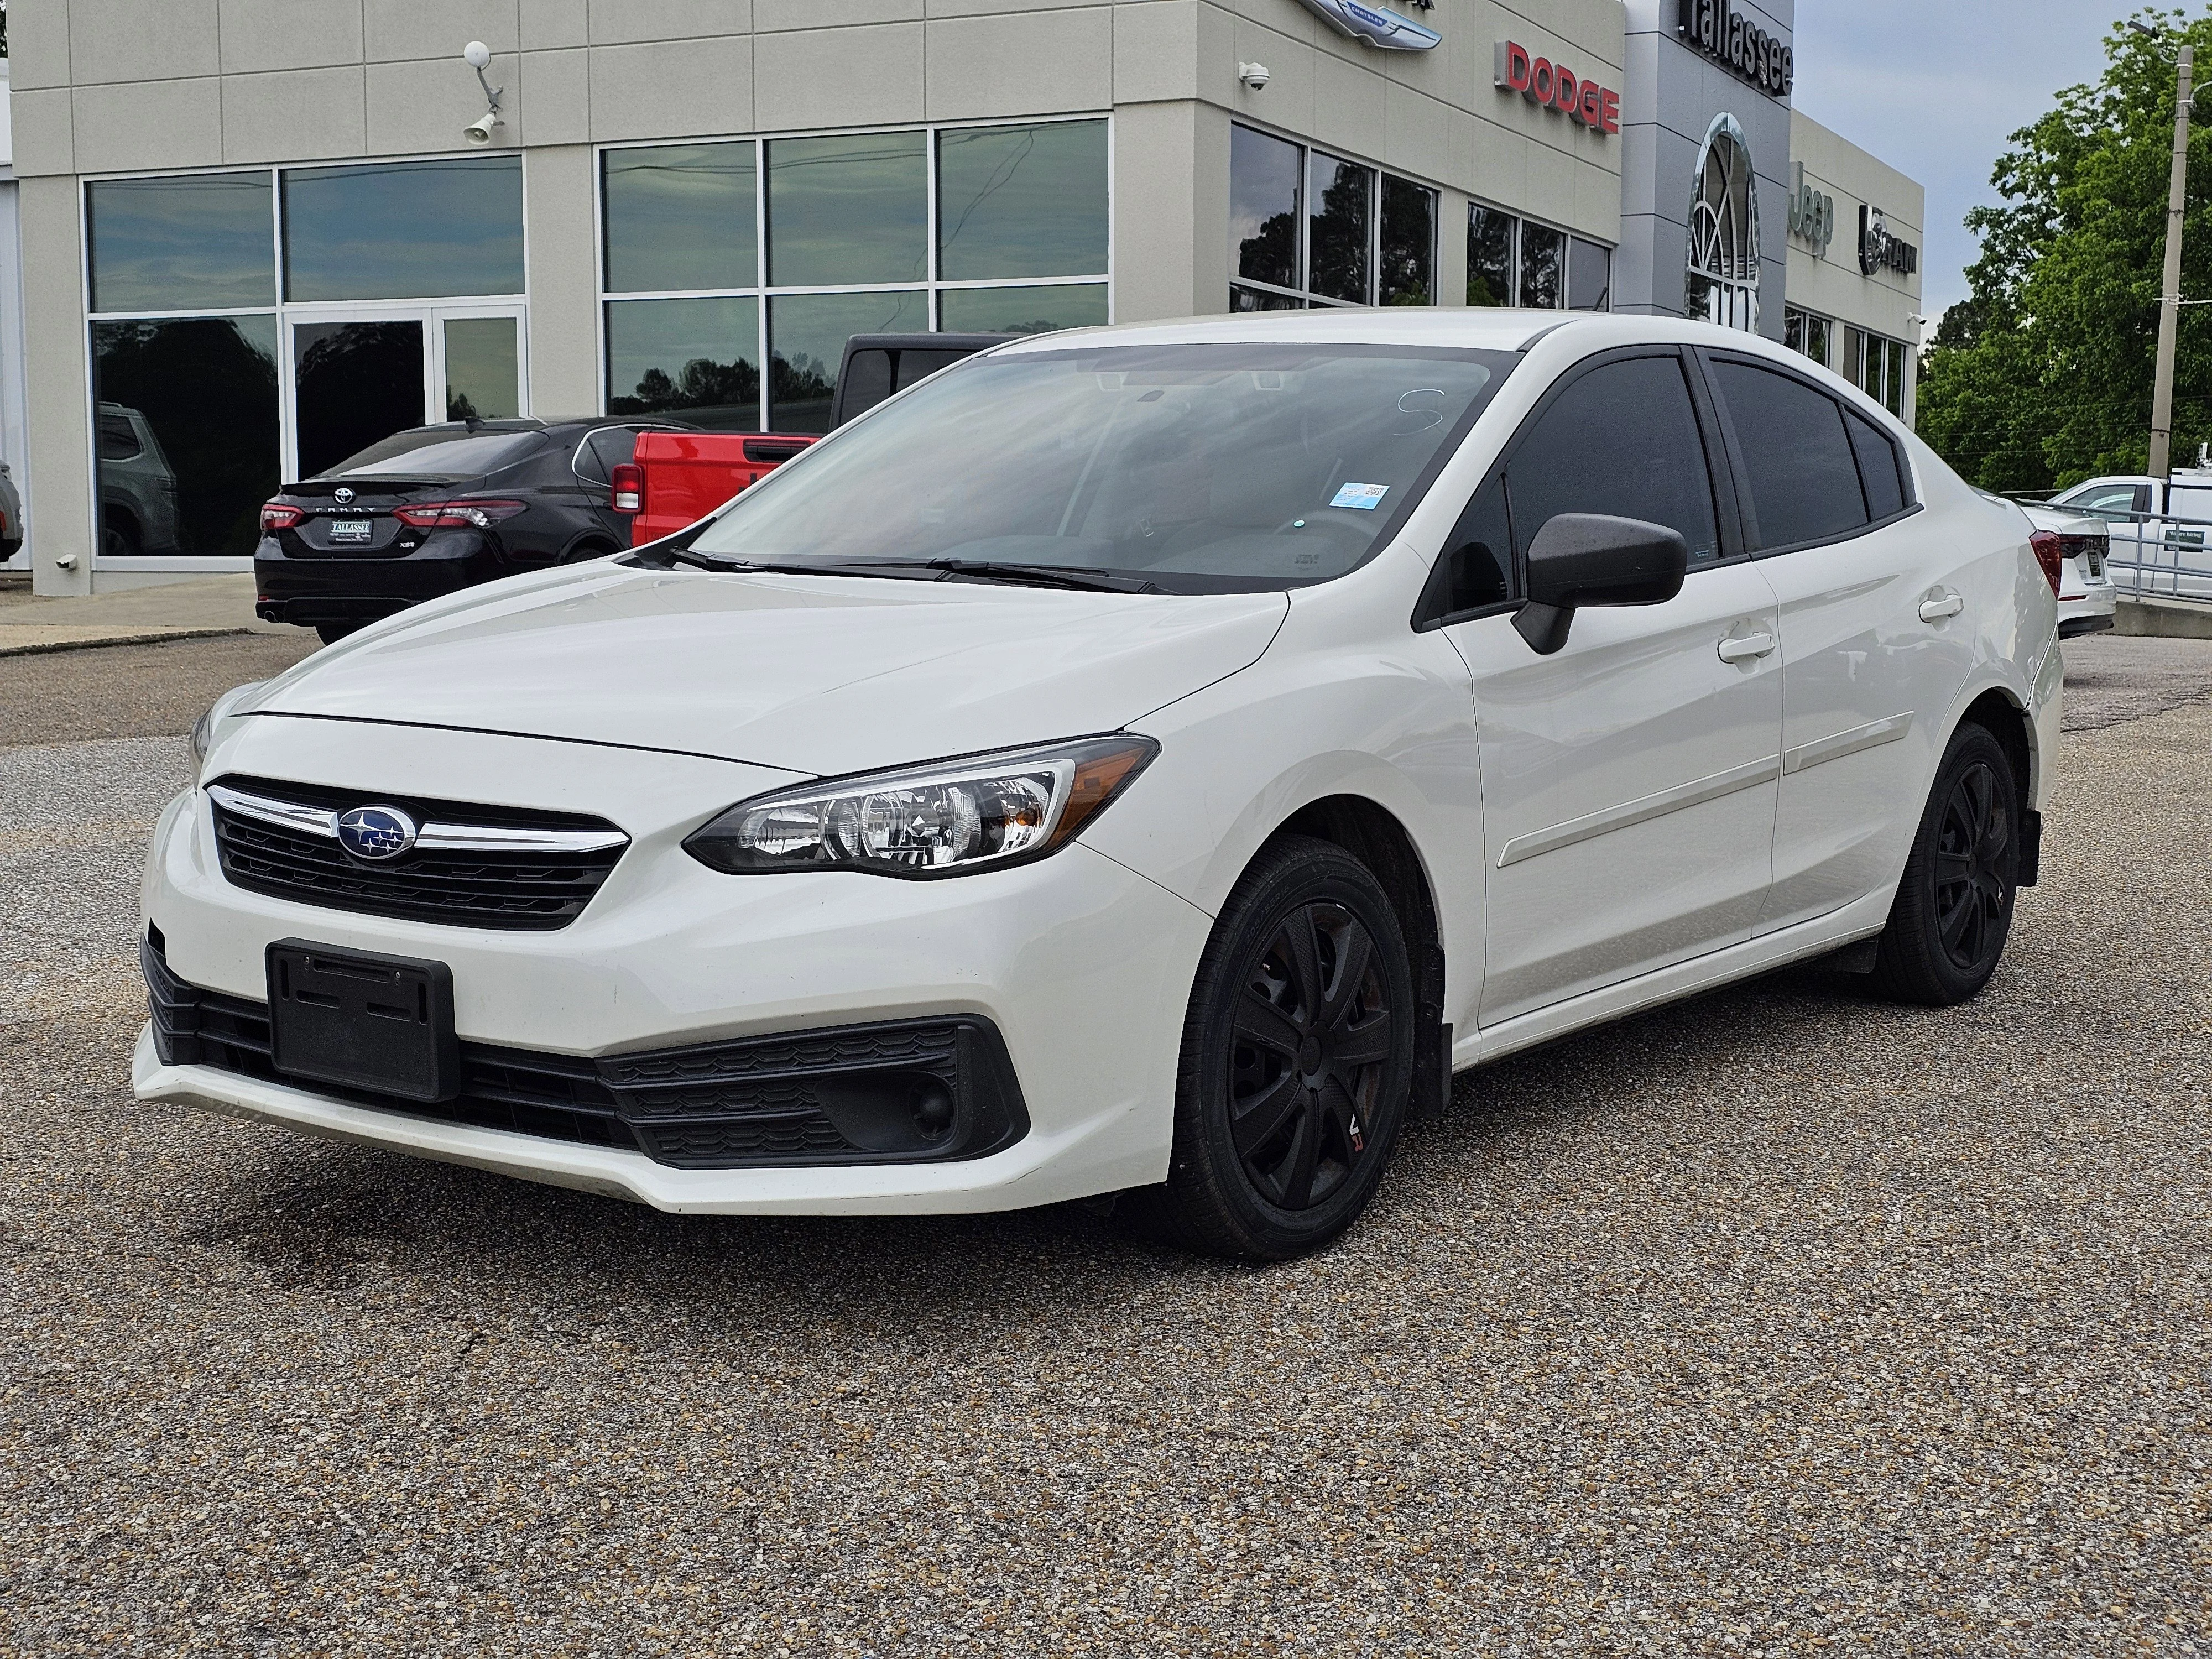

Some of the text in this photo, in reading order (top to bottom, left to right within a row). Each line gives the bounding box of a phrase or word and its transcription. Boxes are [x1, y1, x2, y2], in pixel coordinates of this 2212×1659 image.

[1351, 6, 1383, 25] CHRYSLER
[1495, 40, 1619, 134] DODGE
[1788, 161, 1834, 259] Jeep
[1881, 232, 1917, 274] RAM
[1394, 389, 1445, 436] S
